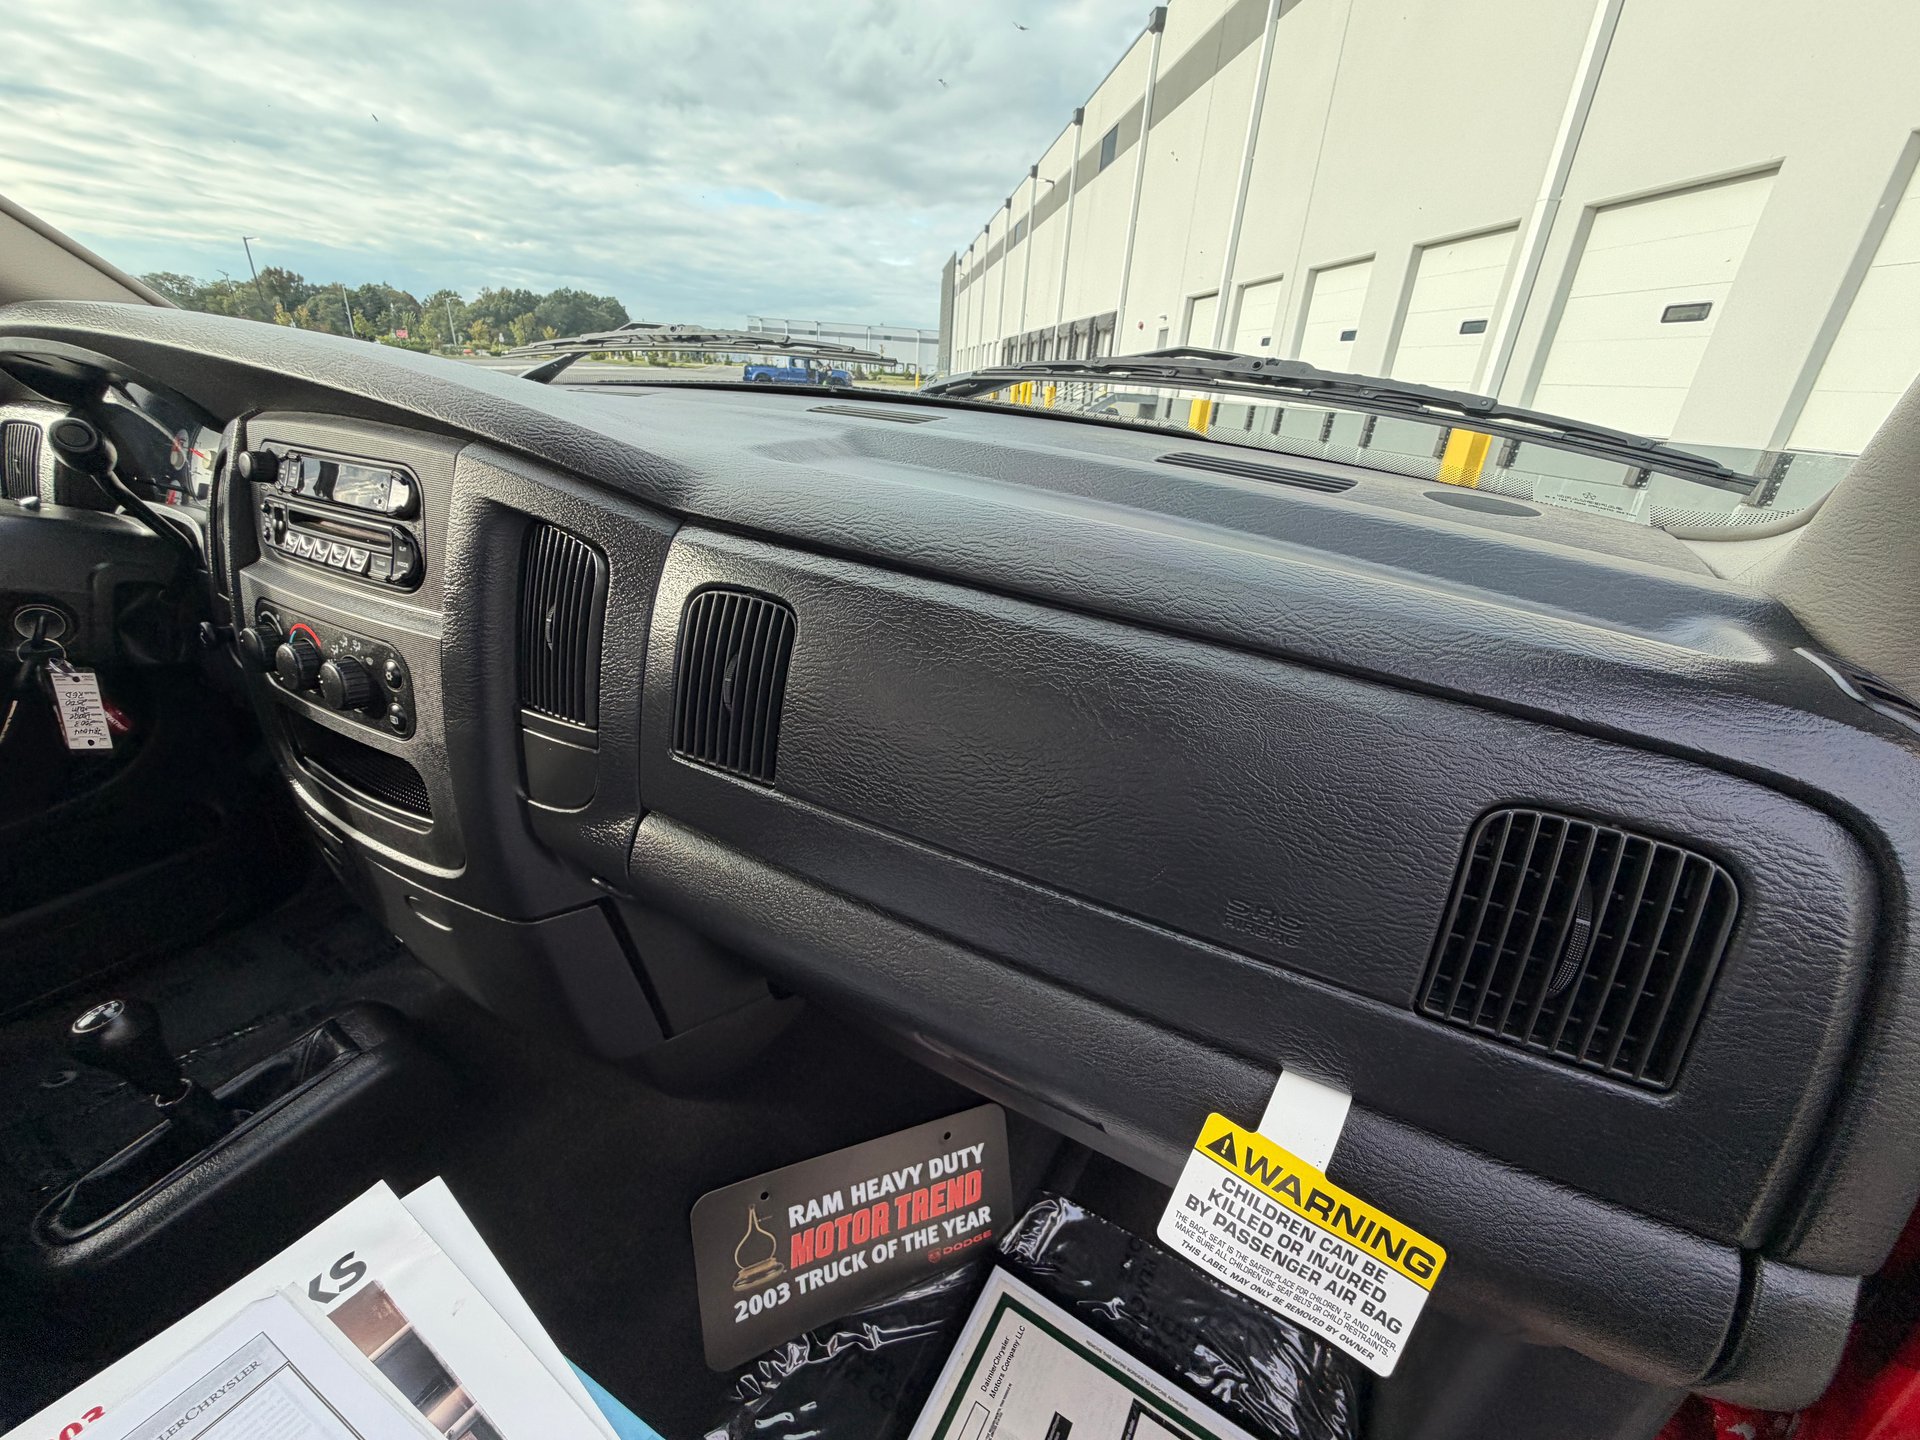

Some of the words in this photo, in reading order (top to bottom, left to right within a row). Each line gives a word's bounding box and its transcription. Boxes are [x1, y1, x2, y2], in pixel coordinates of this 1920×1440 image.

[788, 1191, 844, 1228] RAM
[850, 1163, 924, 1205] HEAVY
[928, 1142, 985, 1180] DUTY
[790, 1207, 891, 1269] MOTOR
[894, 1169, 983, 1230] TREND
[943, 1229, 992, 1255] DODGE
[1222, 1177, 1316, 1243] CHILDREN
[1319, 1237, 1359, 1266] CAN
[1361, 1260, 1388, 1285] BE
[1244, 1146, 1437, 1280] WARNING
[733, 1282, 791, 1323] 2003
[795, 1251, 868, 1295] TRUCK
[871, 1241, 899, 1265] OF
[901, 1225, 940, 1254] THE
[941, 1206, 992, 1239] YEAR
[1174, 1221, 1196, 1239] MAKE
[1196, 1236, 1215, 1252] SURE
[1215, 1248, 1227, 1261] ALL
[1229, 1257, 1263, 1281] CHILDREN
[1262, 1276, 1276, 1289] USE
[1276, 1285, 1293, 1299] SEAT
[1293, 1294, 1311, 1308] BELTS
[1312, 1305, 1323, 1314] OR
[1322, 1309, 1343, 1326] CHILD
[1343, 1323, 1388, 1357] RESTRAINTS.
[1175, 1210, 1188, 1223] THE
[1189, 1220, 1208, 1237] BACK
[1209, 1233, 1226, 1249] SEAT
[1226, 1244, 1234, 1254] IS
[1235, 1250, 1249, 1263] THE
[1248, 1258, 1274, 1277] SAFEST
[1274, 1273, 1296, 1289] PLACE
[1296, 1285, 1309, 1297] FOR
[1309, 1292, 1342, 1314] CHILDREN
[1343, 1311, 1352, 1321] 12
[1352, 1317, 1370, 1332] AND
[1370, 1328, 1398, 1352] UNDER.
[1180, 1240, 1201, 1256] THIS
[1201, 1254, 1228, 1275] LABEL
[1230, 1272, 1250, 1286] MAY
[1250, 1283, 1272, 1299] ONLY
[1272, 1296, 1285, 1306] BE
[1284, 1302, 1325, 1327] REMOVED
[1325, 1324, 1339, 1335] BY
[1338, 1333, 1375, 1361] OWNER
[1185, 1194, 1212, 1217] BY
[1213, 1212, 1322, 1286] PASSENGER
[1324, 1280, 1357, 1306] AIR
[1360, 1300, 1402, 1334] BAG
[1208, 1188, 1273, 1238] KILLED
[1278, 1234, 1304, 1256] OR
[1307, 1249, 1387, 1303] INJURED
[980, 1336, 1010, 1393] DaimlerChrysler
[989, 1373, 1005, 1399] Motors
[1001, 1339, 1020, 1372] Company
[1016, 1325, 1026, 1342] LLC
